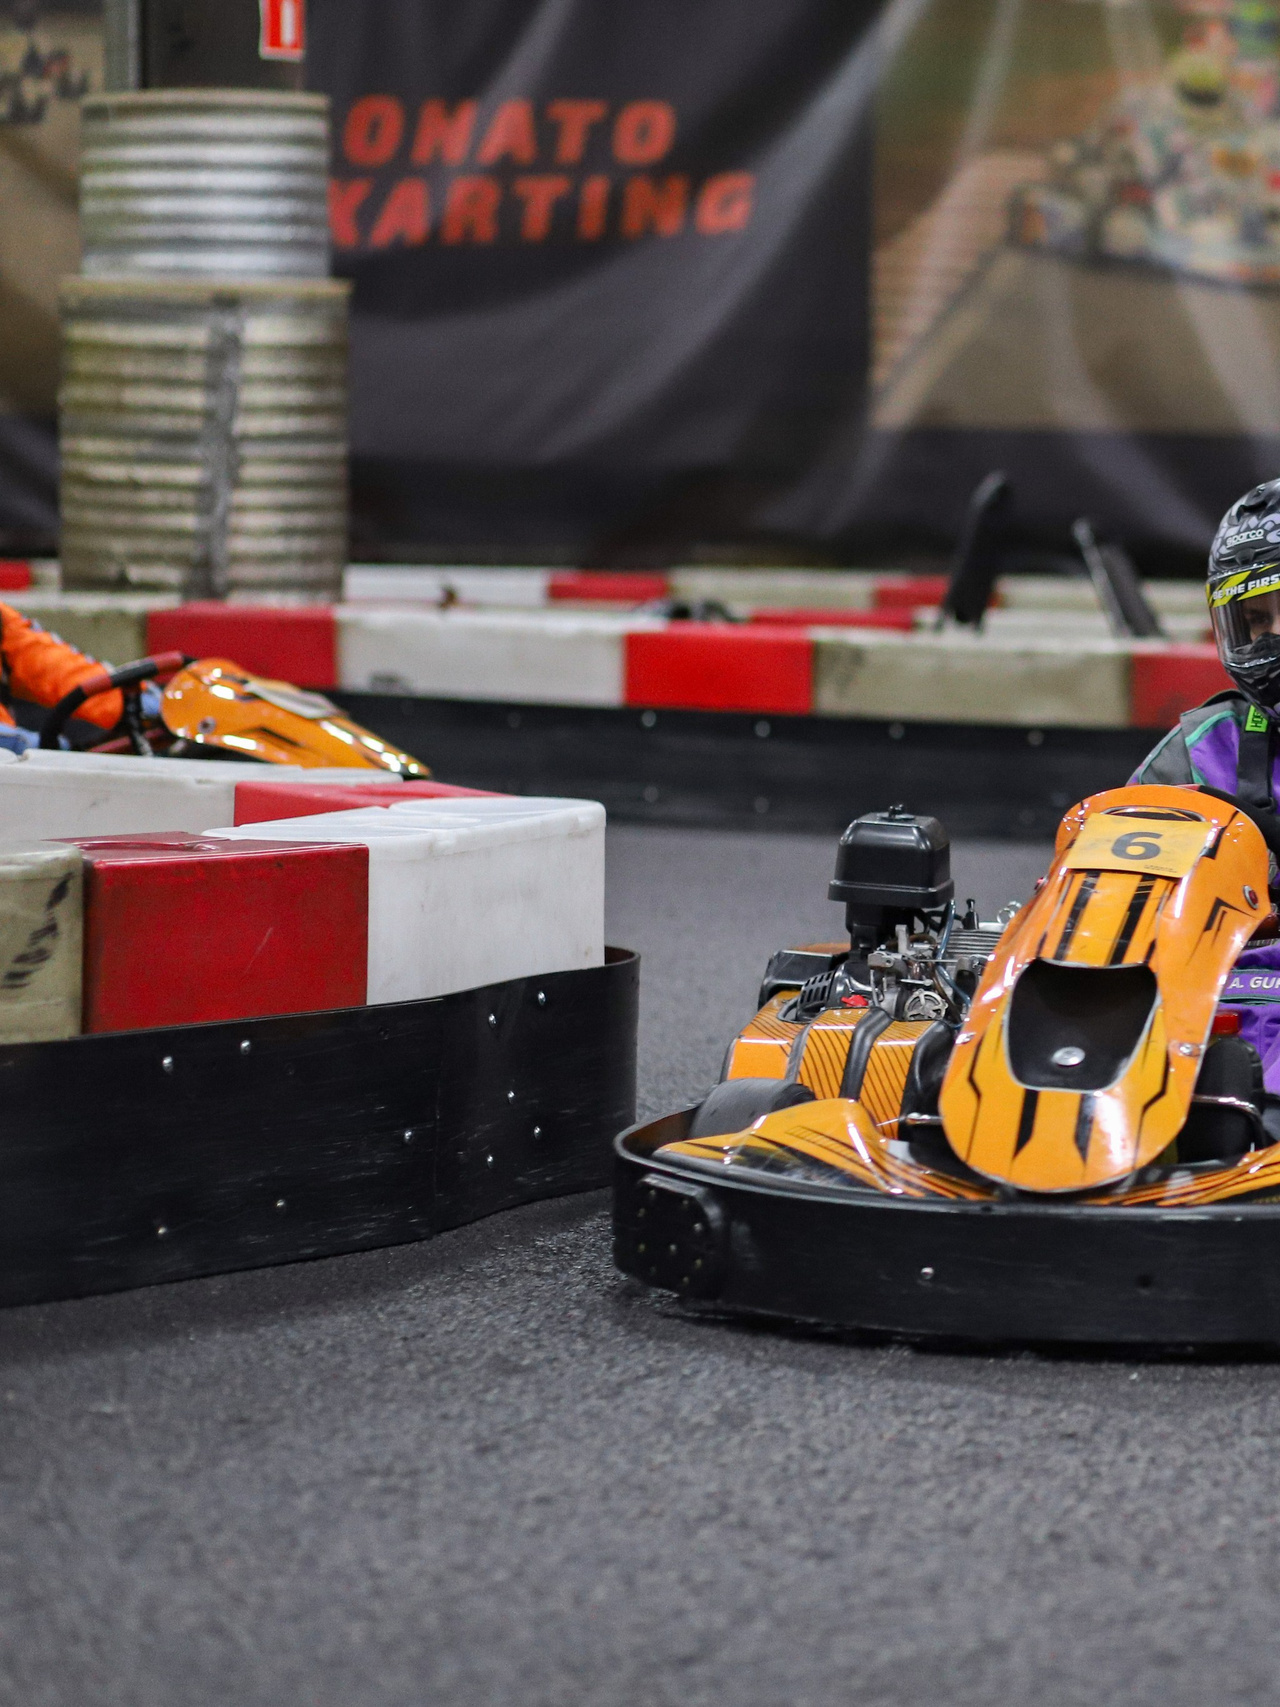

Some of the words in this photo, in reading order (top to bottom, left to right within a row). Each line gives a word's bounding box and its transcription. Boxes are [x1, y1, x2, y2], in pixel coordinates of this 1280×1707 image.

[326, 170, 758, 248] KARTING
[1226, 529, 1264, 547] sparco
[1212, 589, 1223, 600] BE
[1224, 583, 1245, 596] THE
[1111, 831, 1164, 861] 6
[1227, 977, 1244, 989] A.
